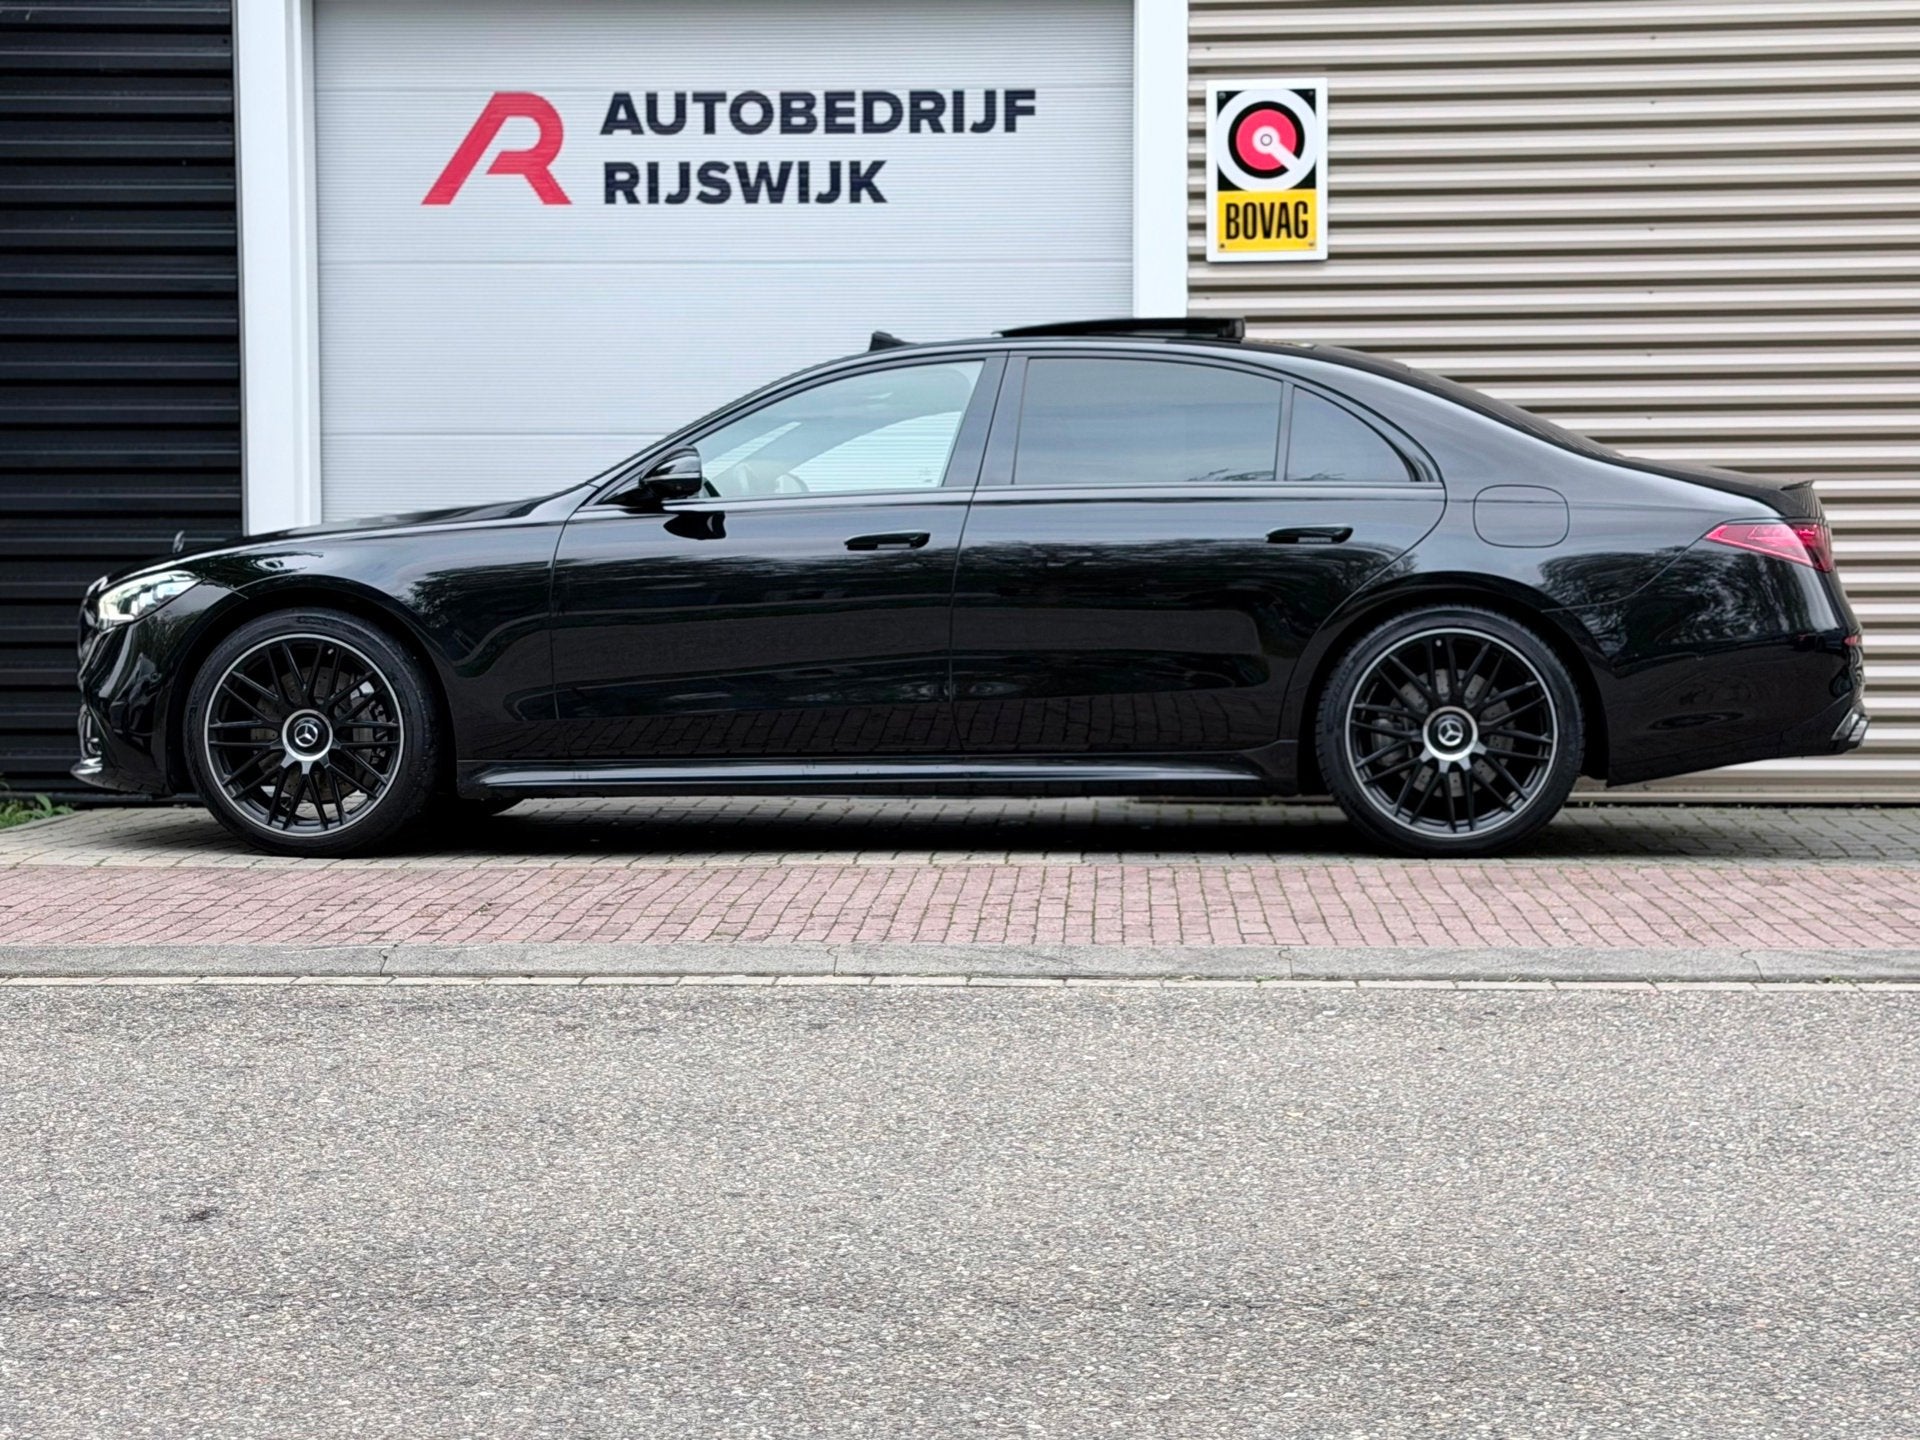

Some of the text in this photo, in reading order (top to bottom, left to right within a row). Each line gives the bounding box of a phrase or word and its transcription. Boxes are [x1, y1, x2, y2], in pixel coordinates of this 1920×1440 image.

[600, 89, 1036, 136] AUTOBEDRIJF
[604, 160, 887, 205] RIJSWIJK
[1225, 201, 1308, 240] BOVAG
